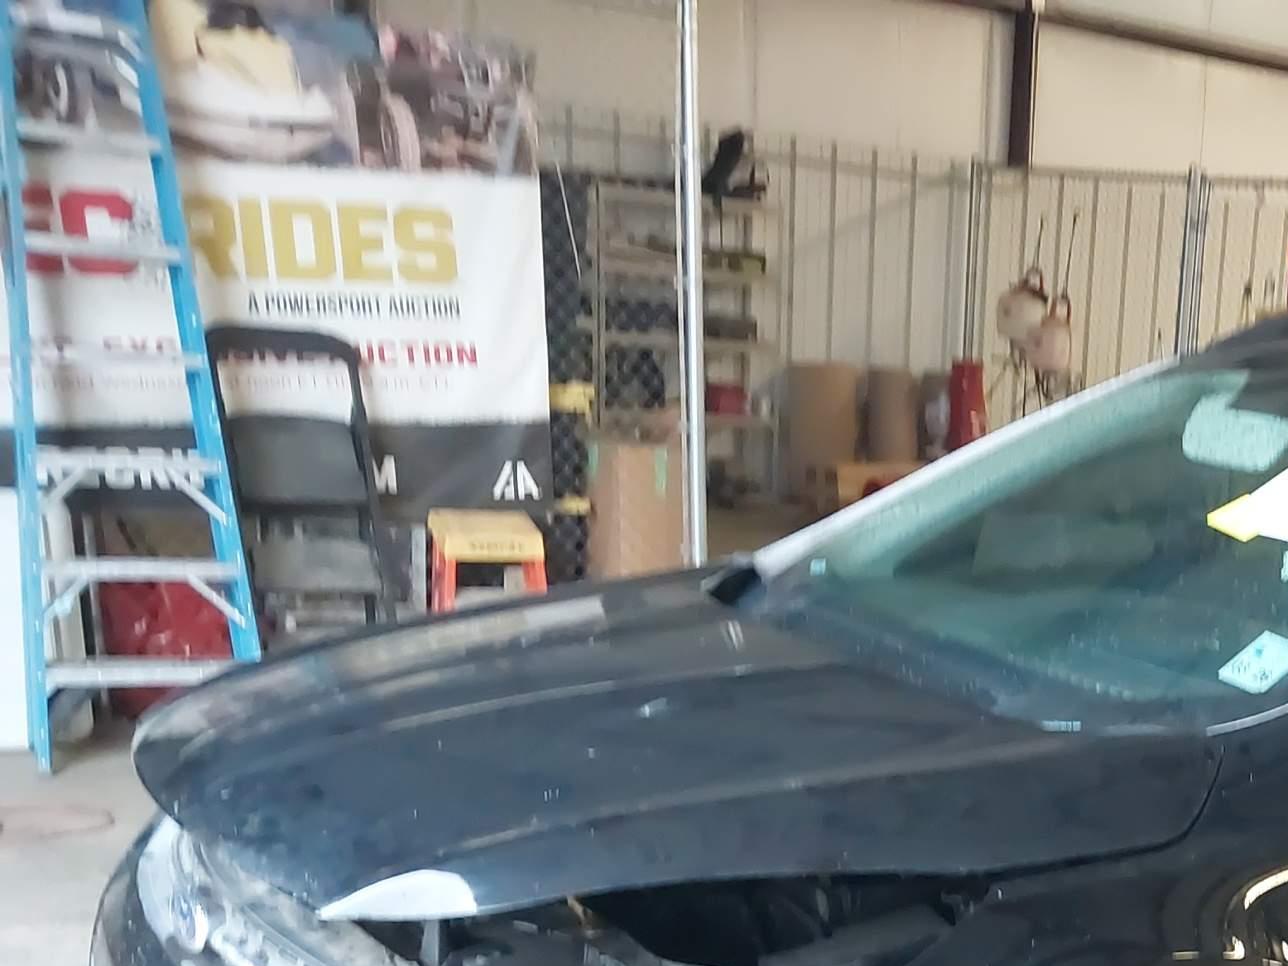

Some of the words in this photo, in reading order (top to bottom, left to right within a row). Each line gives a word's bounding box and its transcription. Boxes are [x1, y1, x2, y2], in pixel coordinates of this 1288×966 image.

[248, 290, 260, 315] A
[388, 293, 461, 321] AUCTION
[340, 339, 479, 368] UCTION
